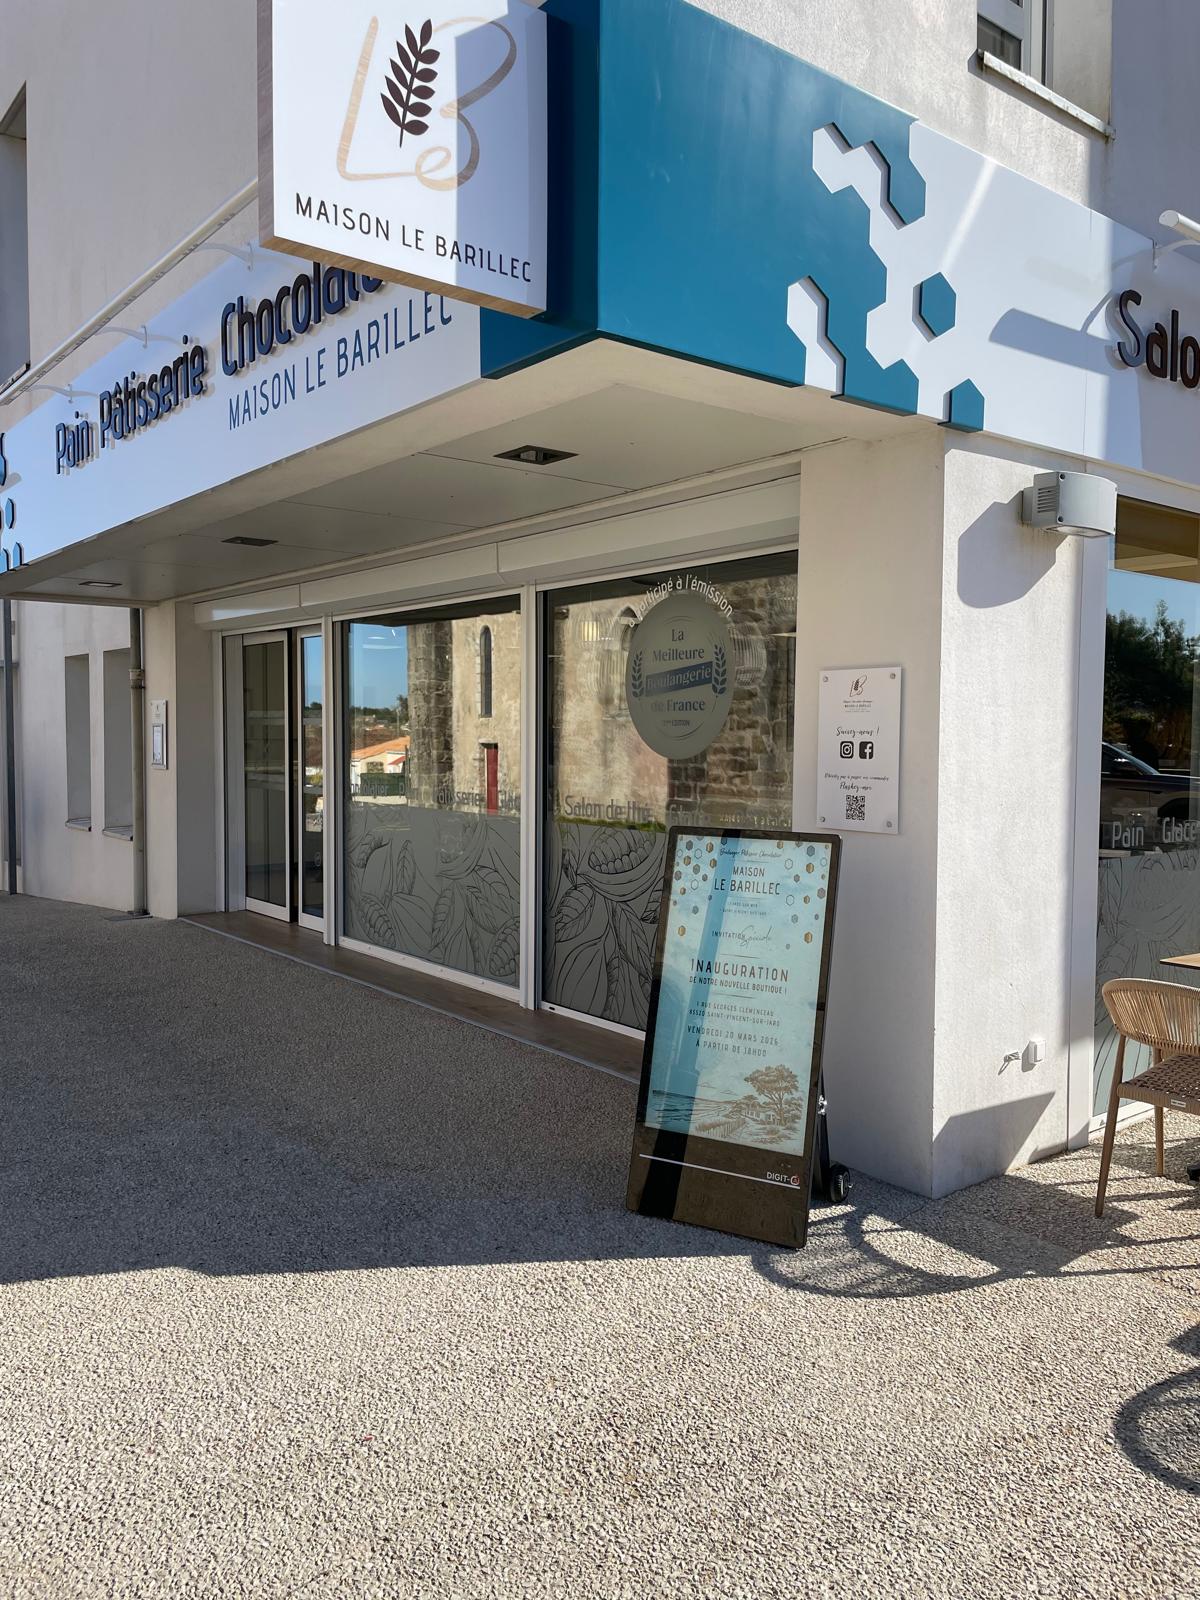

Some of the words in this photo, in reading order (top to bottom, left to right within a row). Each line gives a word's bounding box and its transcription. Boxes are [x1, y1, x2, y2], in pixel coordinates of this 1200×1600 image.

[296, 193, 390, 241] MAISON
[402, 225, 424, 251] LE
[436, 235, 532, 283] BARILLEC
[229, 364, 296, 431] MAISON
[306, 347, 327, 394] LE
[337, 290, 452, 378] BARILLEC
[56, 411, 91, 474] Pain
[100, 335, 206, 449] Pâtisserie
[676, 576, 683, 590] à
[685, 574, 735, 618] l'émission
[671, 629, 685, 642] La
[653, 647, 705, 662] Meilleure
[667, 698, 705, 712] France
[564, 795, 605, 819] Salon
[1112, 820, 1144, 849] Pain
[732, 866, 765, 878] MAISON
[714, 878, 726, 891] LE
[730, 880, 782, 896] BARILLEC
[712, 930, 746, 941] INVITATION
[691, 959, 789, 982] INAUGURATION
[689, 976, 697, 984] DE
[698, 977, 718, 987] NOTRE
[719, 979, 750, 990] NOUVELLE
[752, 983, 783, 994] BOUTIQUE
[687, 1025, 722, 1038] VENDREDI
[725, 1030, 734, 1039] 20
[737, 1032, 758, 1042] MARS
[703, 1040, 729, 1051] PARTIR
[732, 1045, 740, 1054] DE
